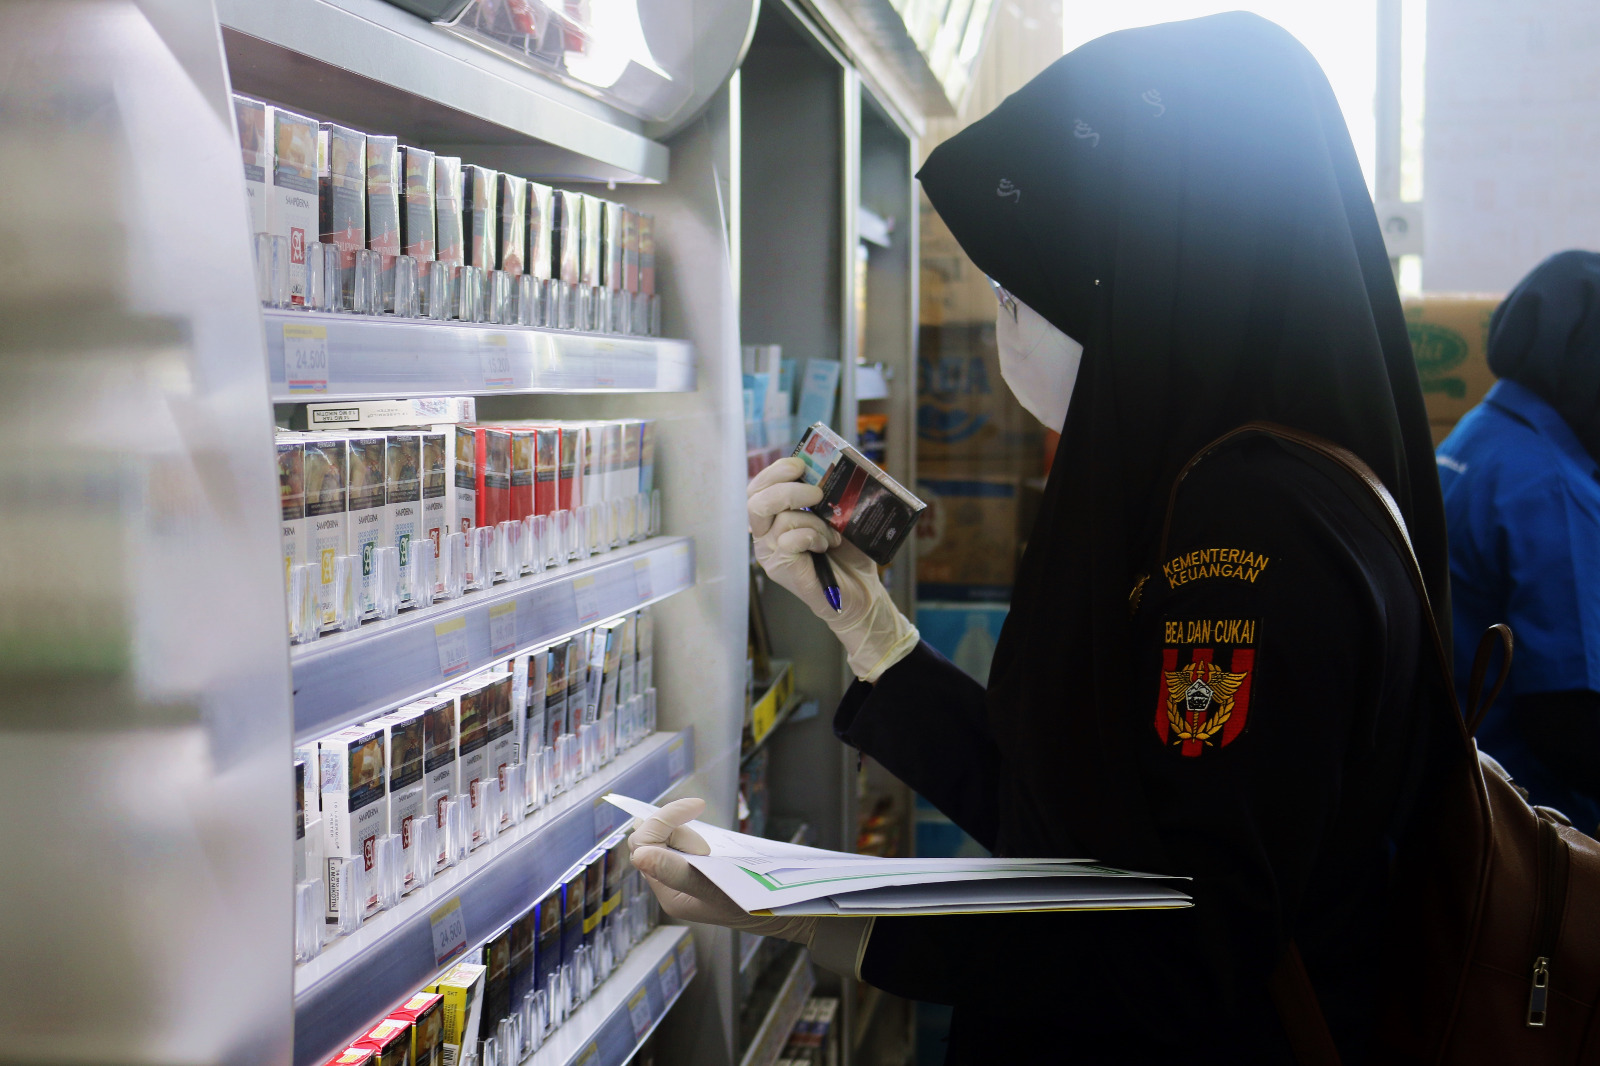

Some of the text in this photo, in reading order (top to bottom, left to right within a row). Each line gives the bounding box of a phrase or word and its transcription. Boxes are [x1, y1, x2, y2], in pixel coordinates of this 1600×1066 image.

[296, 350, 326, 369] 24.500
[1162, 548, 1269, 577] KEMENTERIAN
[1169, 564, 1260, 590] KEUANGAN
[1165, 619, 1255, 644] BEA DAN CUKAI
